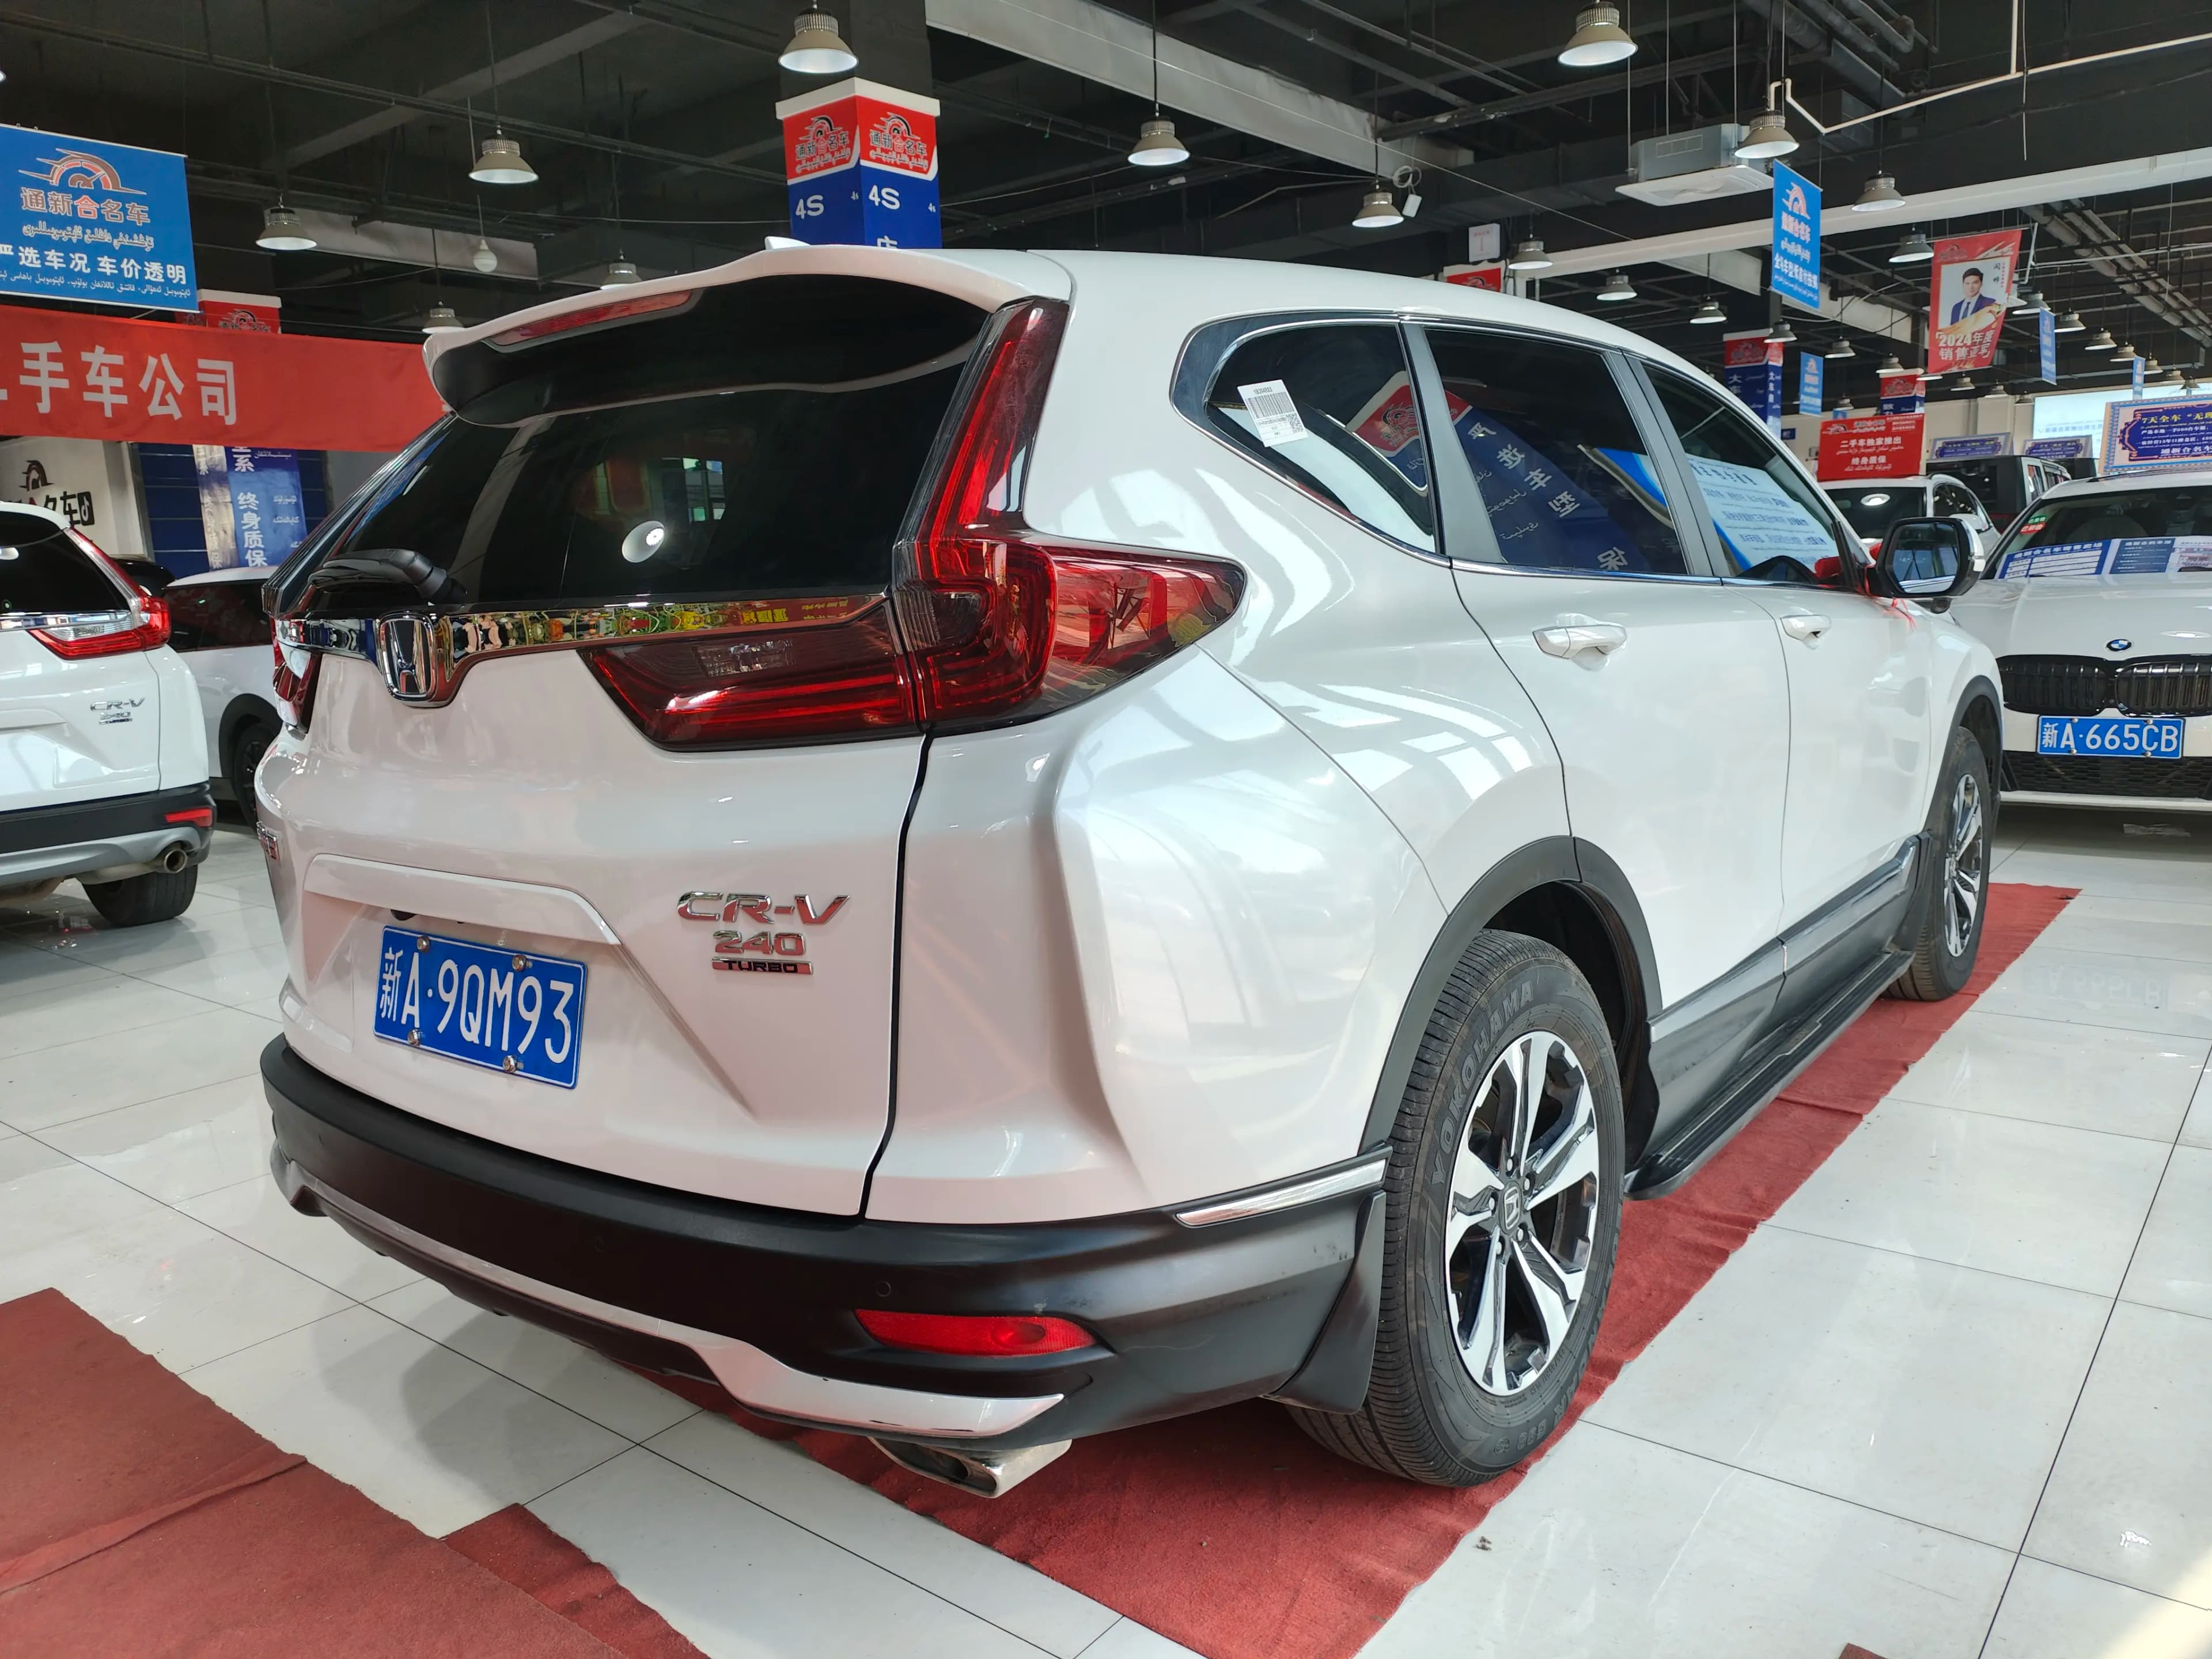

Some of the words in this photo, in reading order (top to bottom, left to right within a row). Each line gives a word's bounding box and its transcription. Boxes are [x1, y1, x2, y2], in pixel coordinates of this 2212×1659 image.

[20, 187, 151, 226] 通新合名车
[795, 194, 824, 219] 4S
[868, 185, 900, 210] 4S
[97, 255, 187, 285] 车价透明
[0, 341, 237, 425] 手车公司
[237, 492, 268, 567] 终身质保
[90, 697, 146, 711] CR-V
[676, 891, 851, 925] CR-V
[712, 930, 805, 956] 240
[724, 960, 798, 975] TURBO
[1431, 981, 1534, 1185] YOKOHAMA
